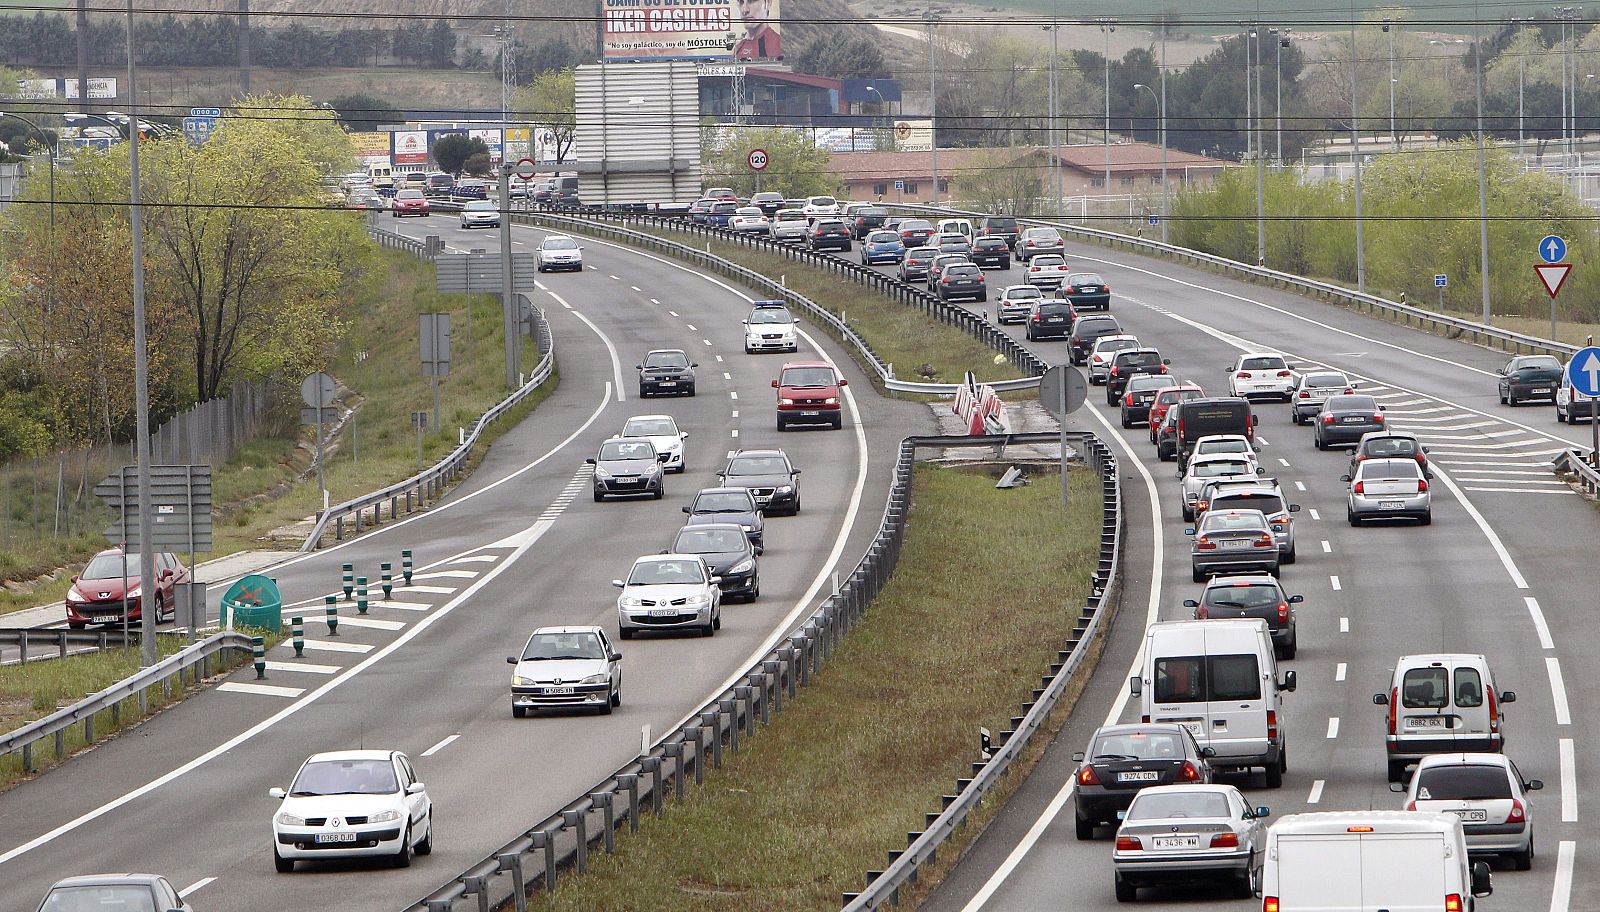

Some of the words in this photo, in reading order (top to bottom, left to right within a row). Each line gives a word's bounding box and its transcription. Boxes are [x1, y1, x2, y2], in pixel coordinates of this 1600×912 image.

[606, 10, 645, 32] IKER
[650, 9, 730, 32] CASILLAS
[751, 156, 766, 164] 120
[1124, 772, 1141, 780] 9274
[1143, 772, 1156, 780] CDK
[321, 834, 338, 842] 0368
[1156, 839, 1161, 847] M
